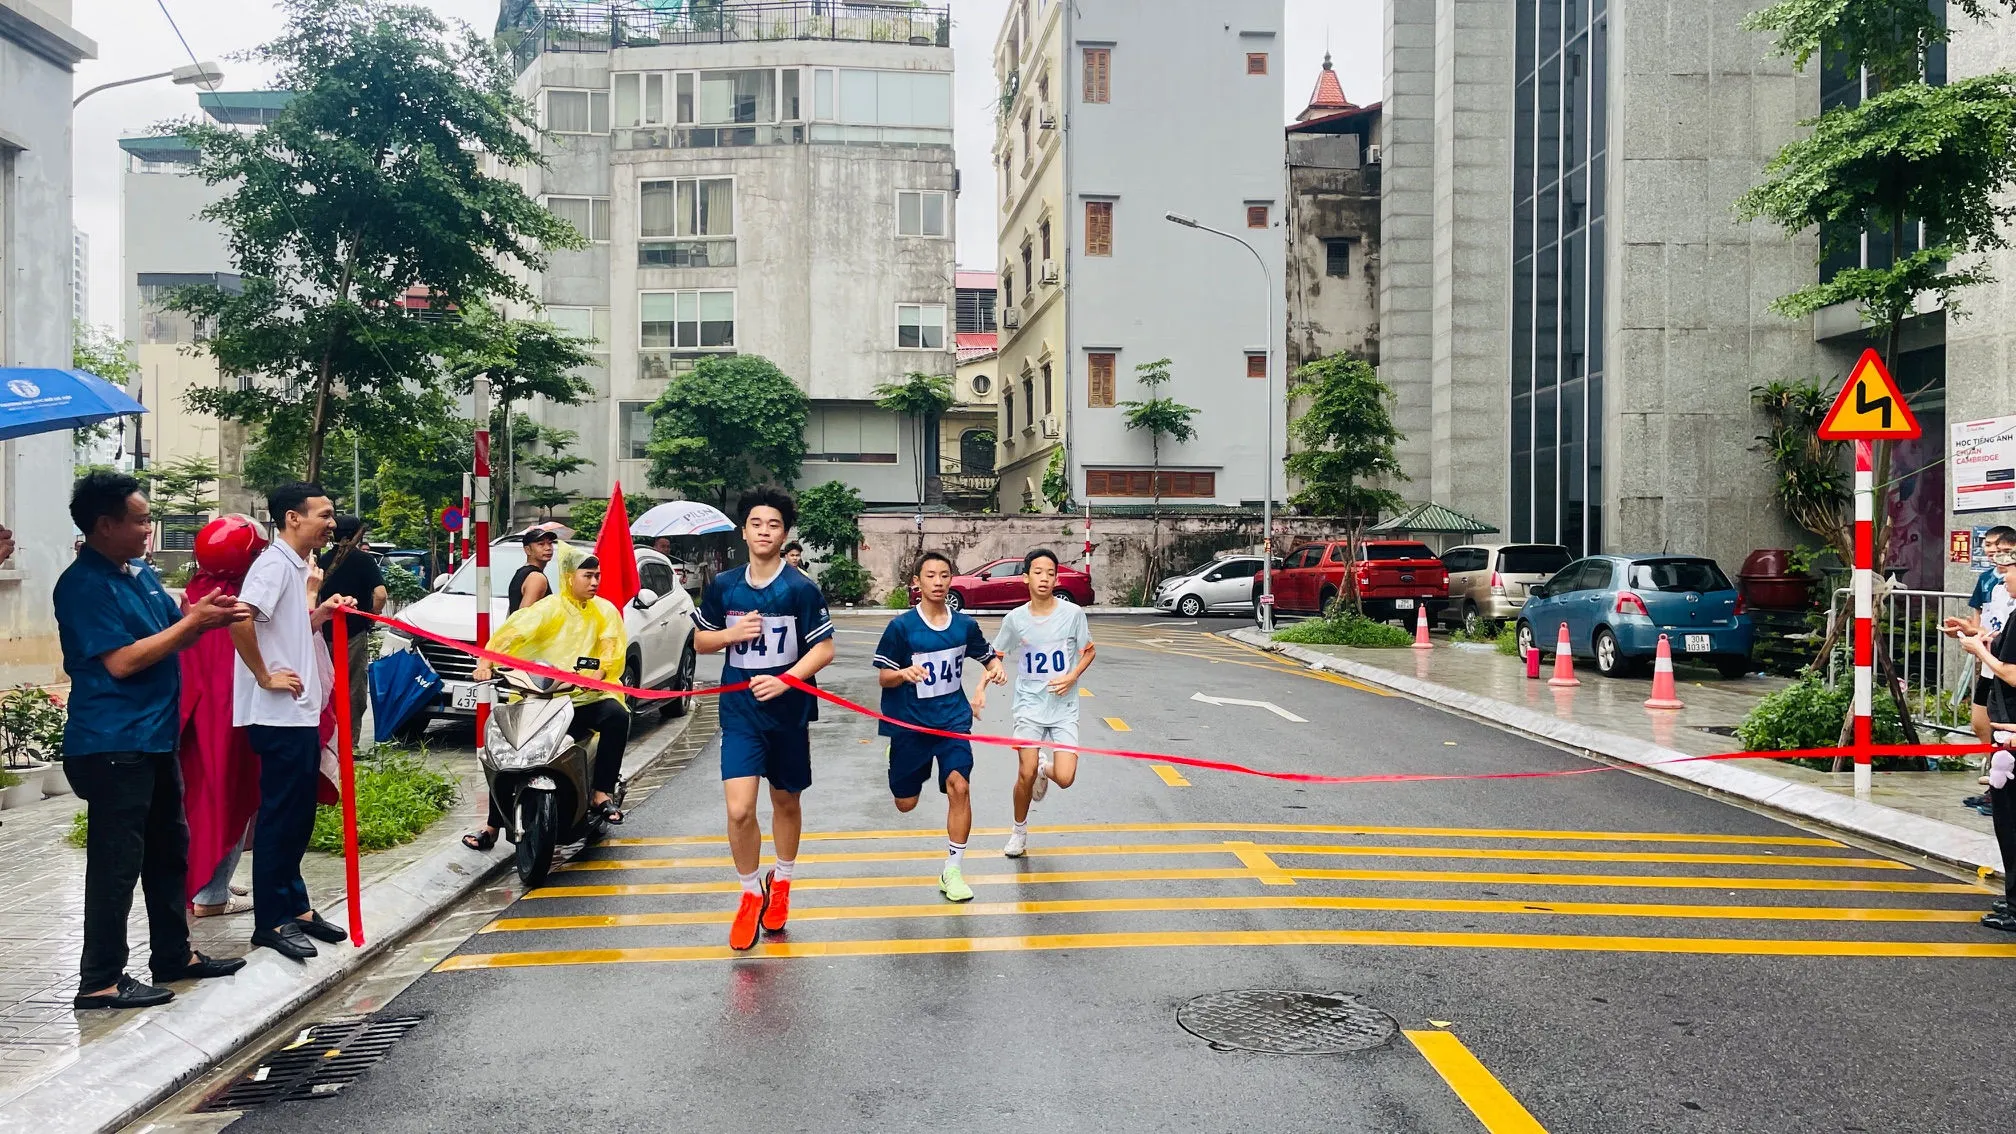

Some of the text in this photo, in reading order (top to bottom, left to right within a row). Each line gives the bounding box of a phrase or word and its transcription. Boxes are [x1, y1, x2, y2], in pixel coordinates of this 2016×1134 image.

[1956, 454, 2000, 465] CAMBRIDGE
[921, 654, 963, 686] 345
[1025, 650, 1065, 673] 120
[457, 698, 477, 708] 437
